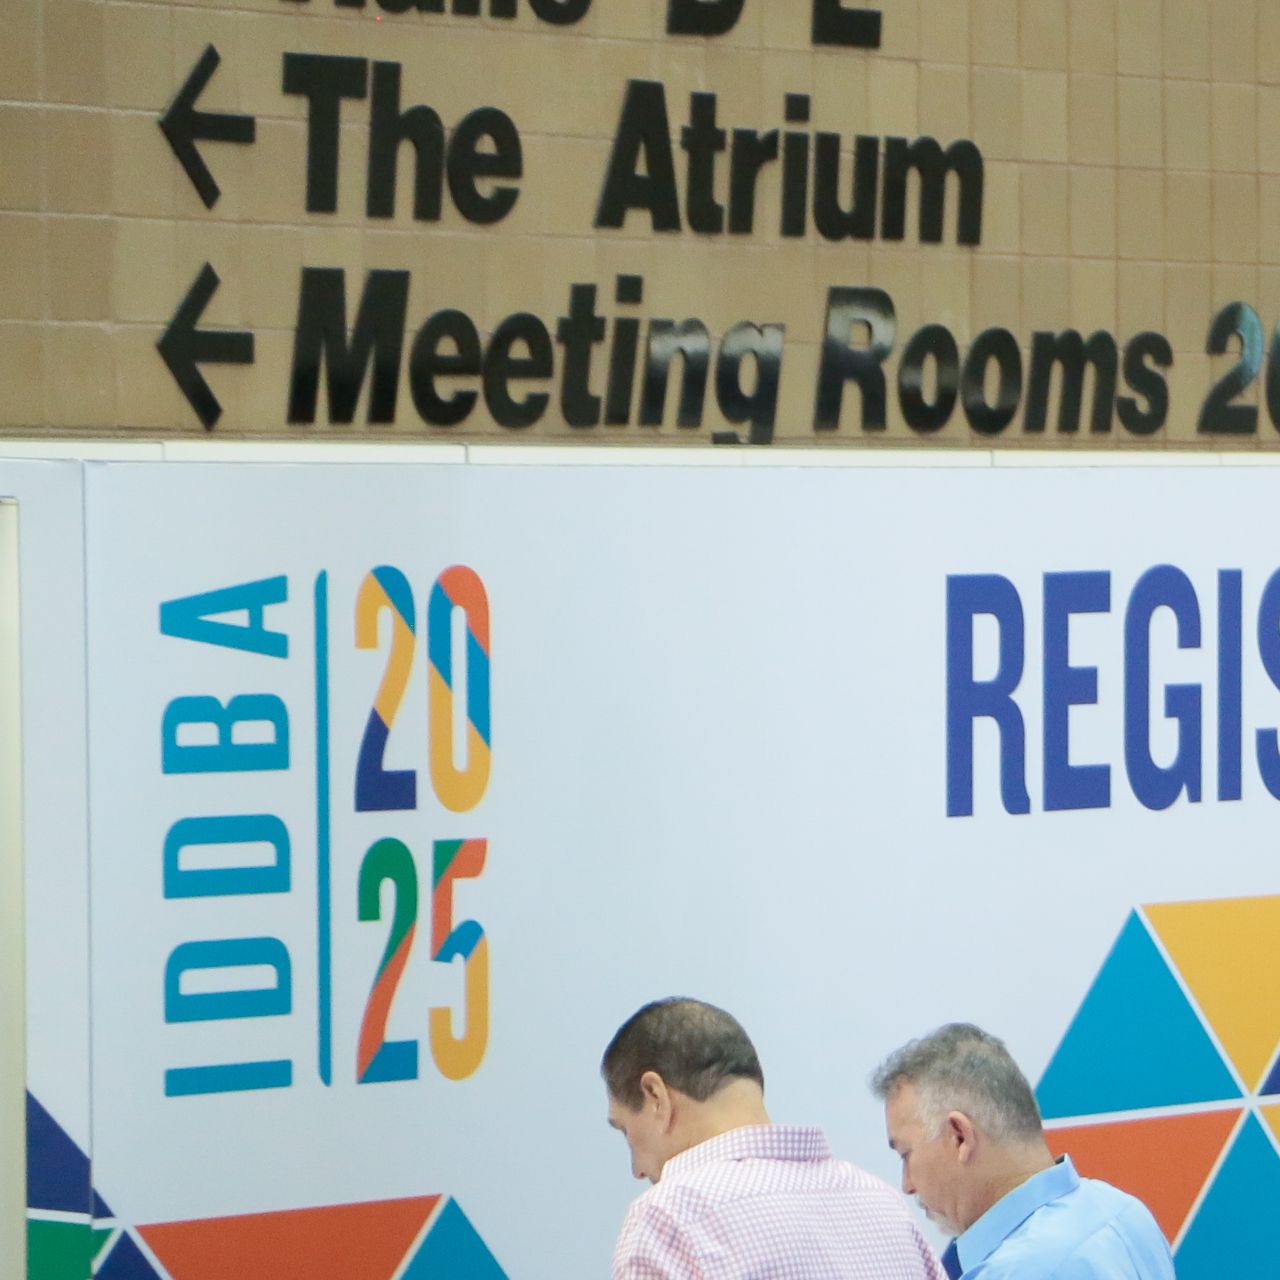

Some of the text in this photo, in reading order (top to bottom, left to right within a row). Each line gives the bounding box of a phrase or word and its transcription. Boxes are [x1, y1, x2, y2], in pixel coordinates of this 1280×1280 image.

[282, 52, 983, 247] The Atrium
[286, 266, 785, 445] Meeting
[812, 285, 1174, 436] Rooms
[355, 564, 491, 813] 20
[160, 574, 293, 1098] IDDBA
[356, 837, 490, 1085] 25
